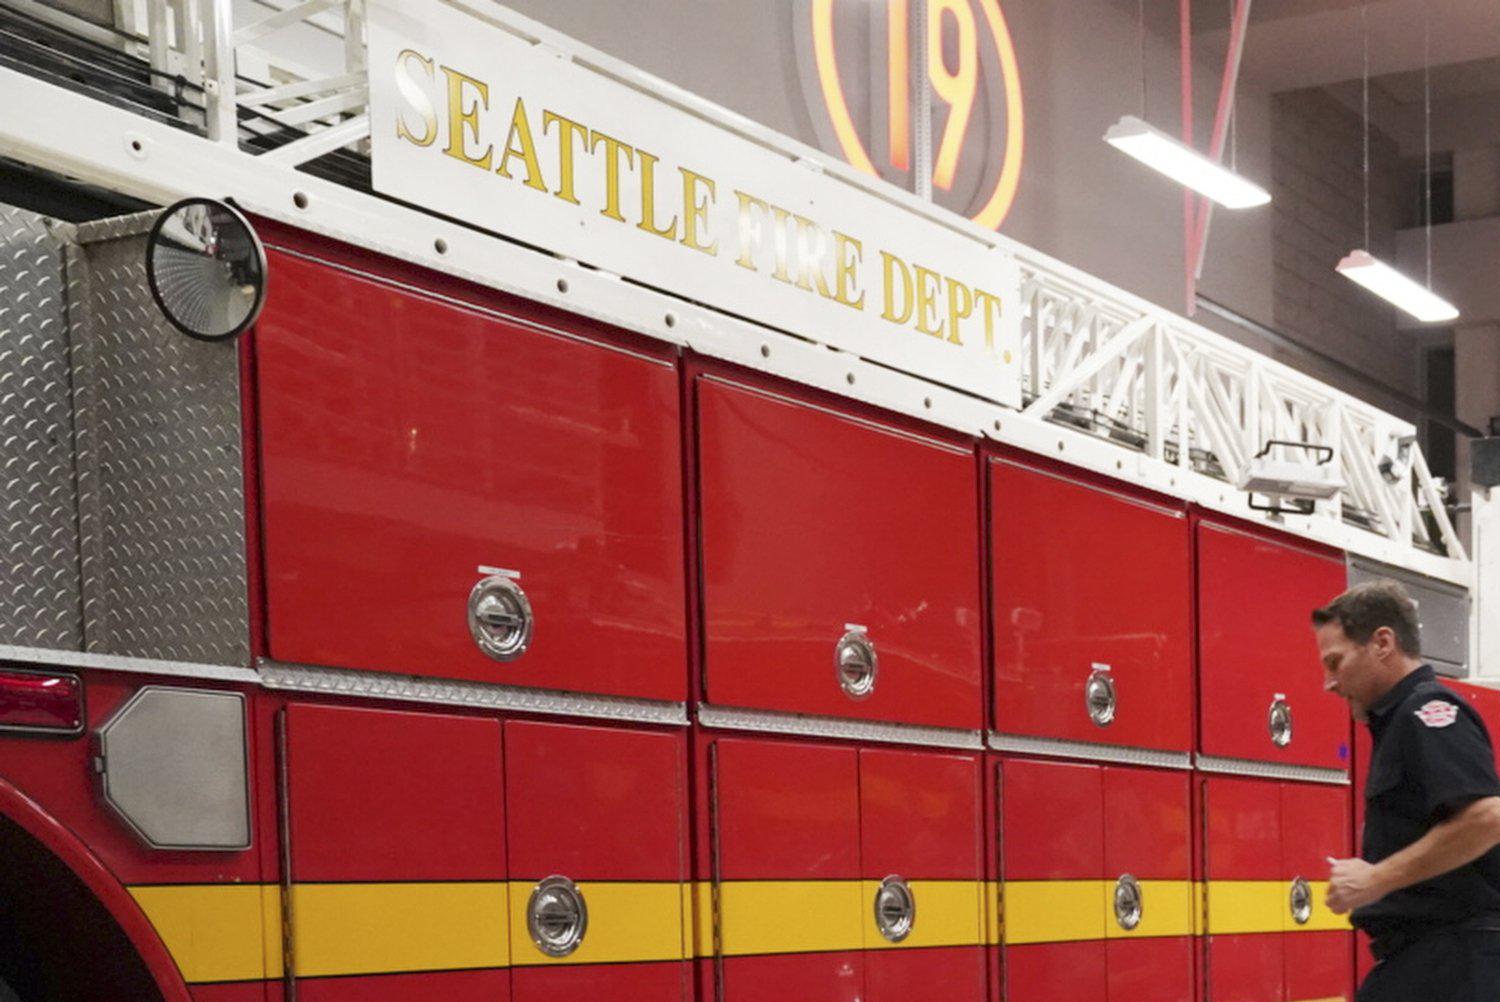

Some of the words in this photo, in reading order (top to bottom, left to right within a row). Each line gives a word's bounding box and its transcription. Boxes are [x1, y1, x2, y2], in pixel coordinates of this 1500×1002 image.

[395, 49, 718, 257] SEATTLE
[734, 190, 866, 312] FIRE
[879, 250, 1012, 365] DEPT.
[887, 0, 977, 193] 19
